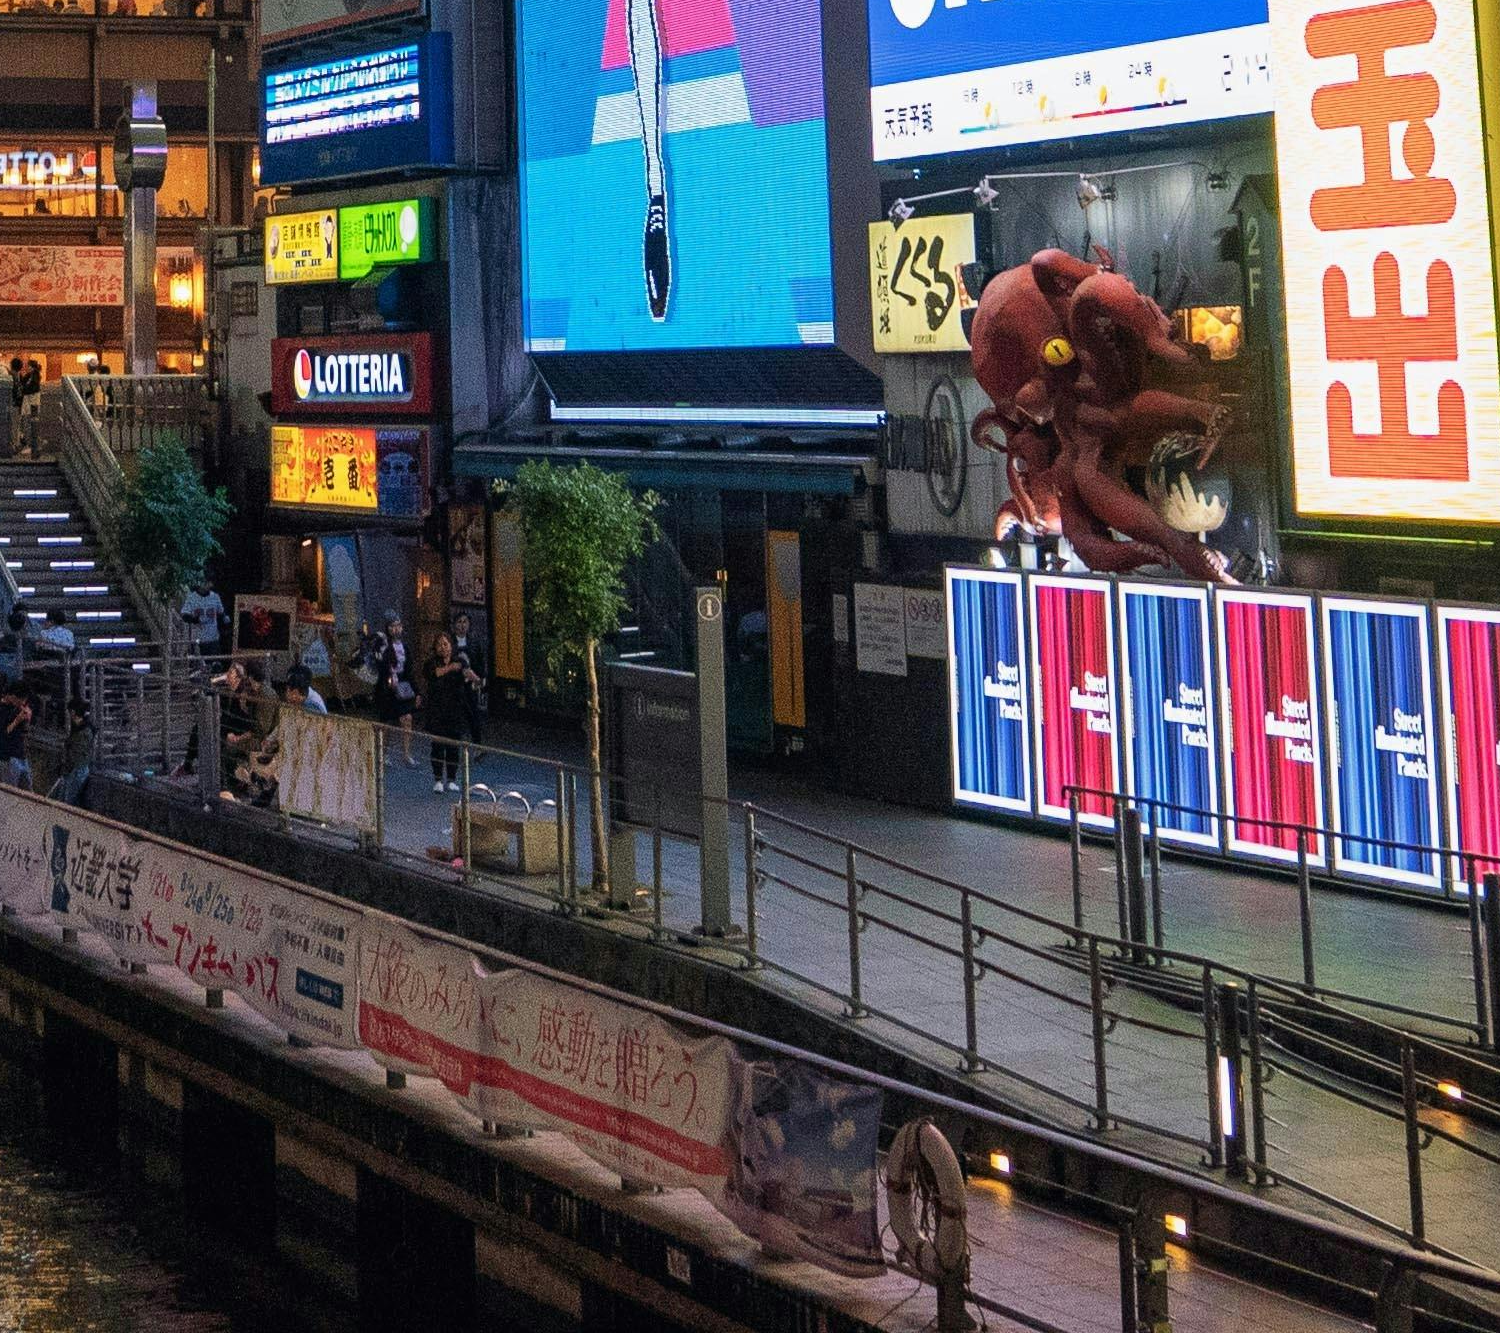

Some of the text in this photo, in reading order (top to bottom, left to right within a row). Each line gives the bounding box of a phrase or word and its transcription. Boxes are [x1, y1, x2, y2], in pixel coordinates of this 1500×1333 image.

[891, 235, 956, 331] くくる
[314, 353, 404, 394] LOTTERIA
